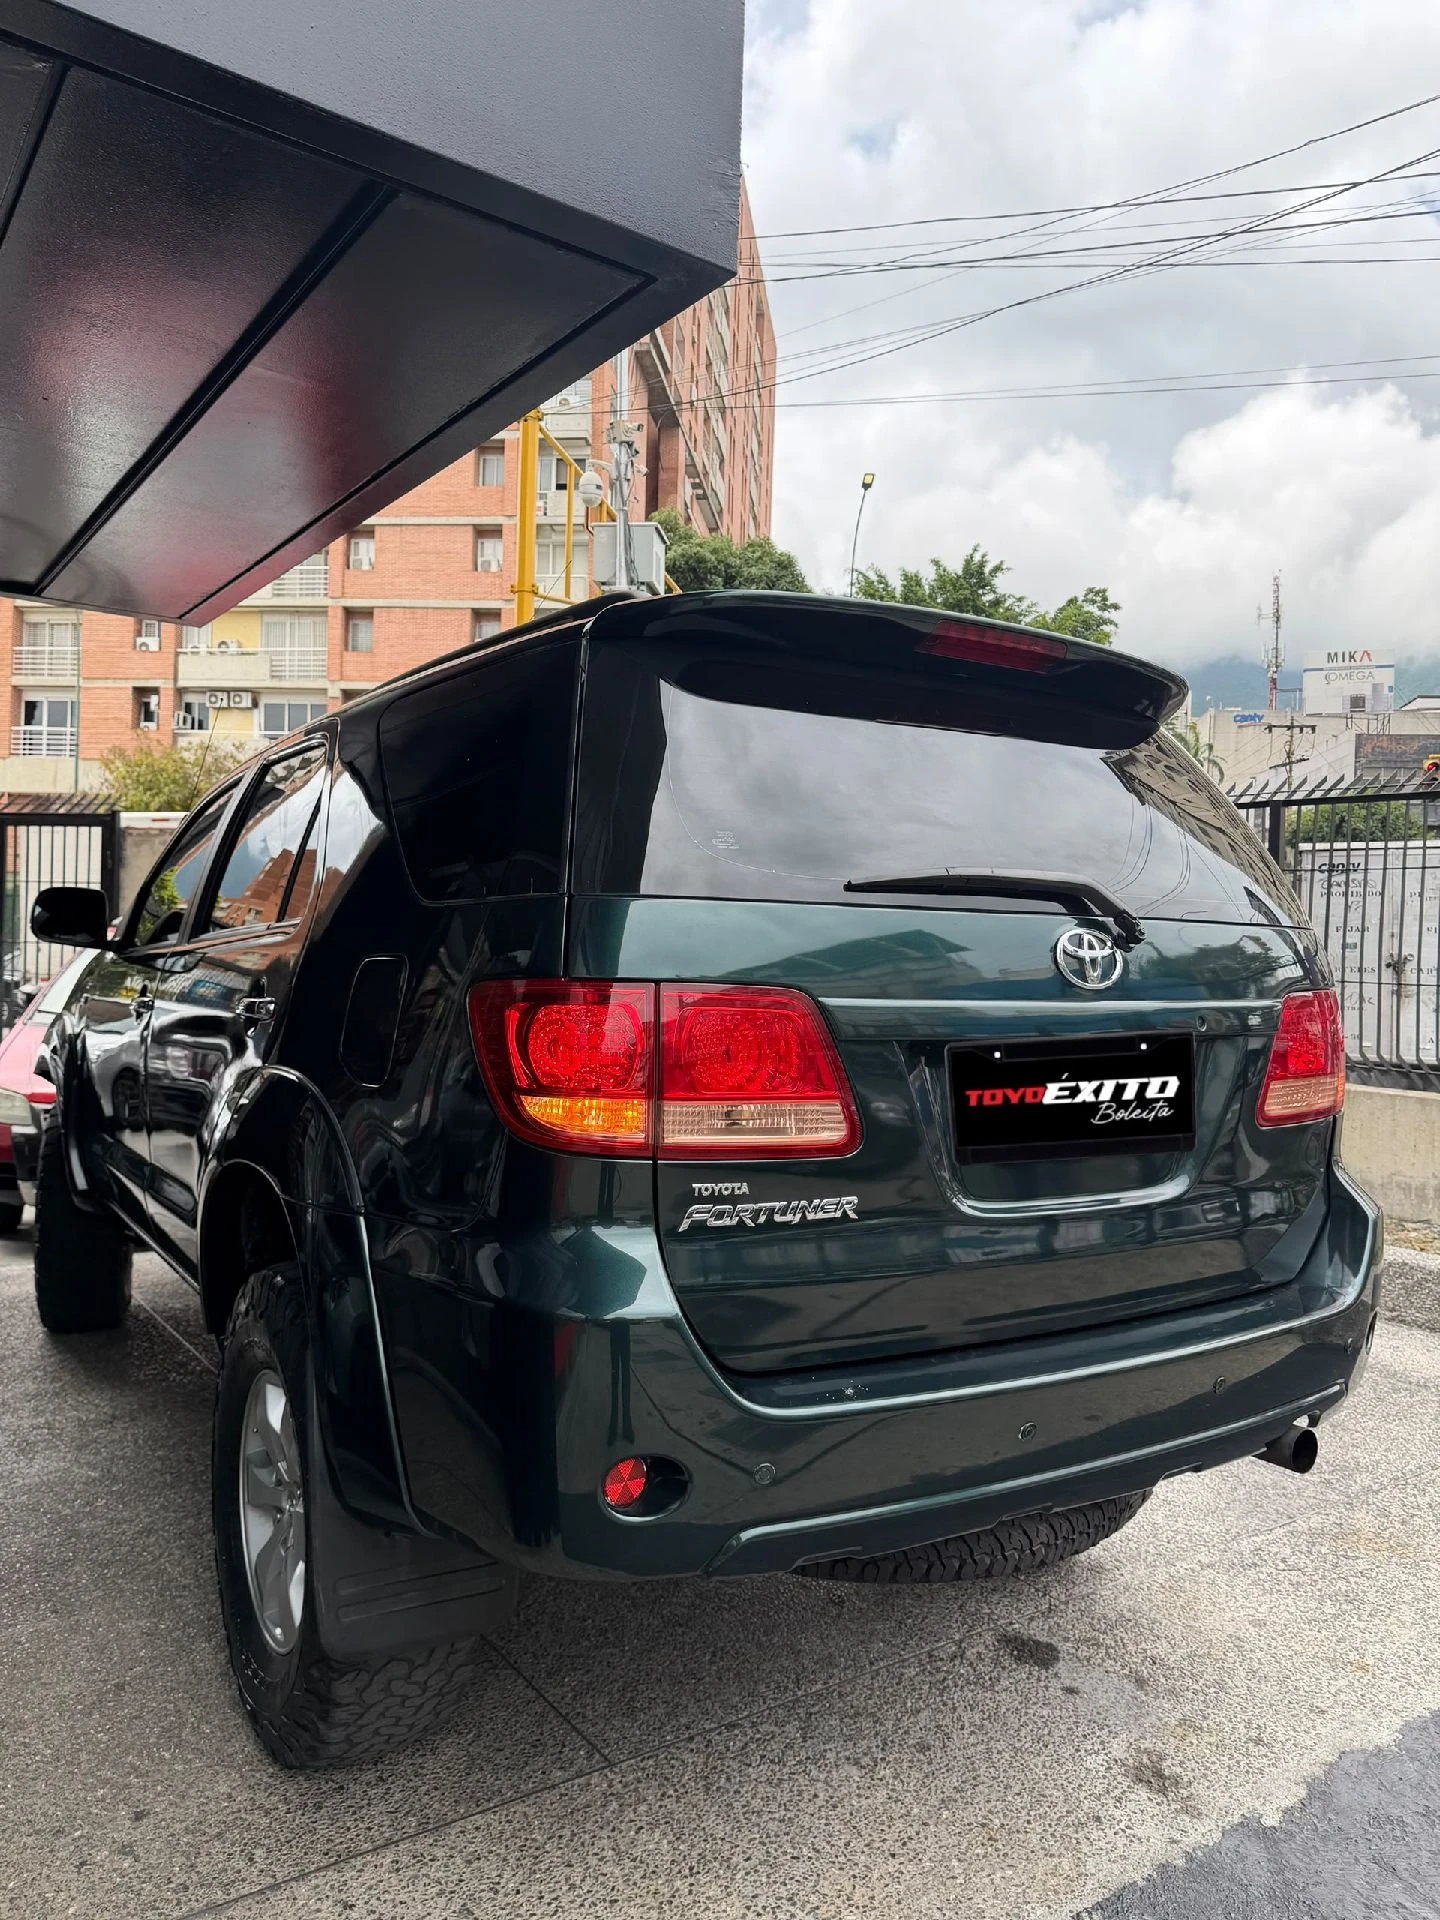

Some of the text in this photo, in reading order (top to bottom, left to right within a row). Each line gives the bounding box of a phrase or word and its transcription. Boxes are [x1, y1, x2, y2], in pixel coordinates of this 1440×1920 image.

[1327, 650, 1373, 664] MIKA
[1325, 671, 1375, 684] OMEGA
[692, 1182, 750, 1197] TOYOTA
[678, 1195, 859, 1233] FORTUNER
